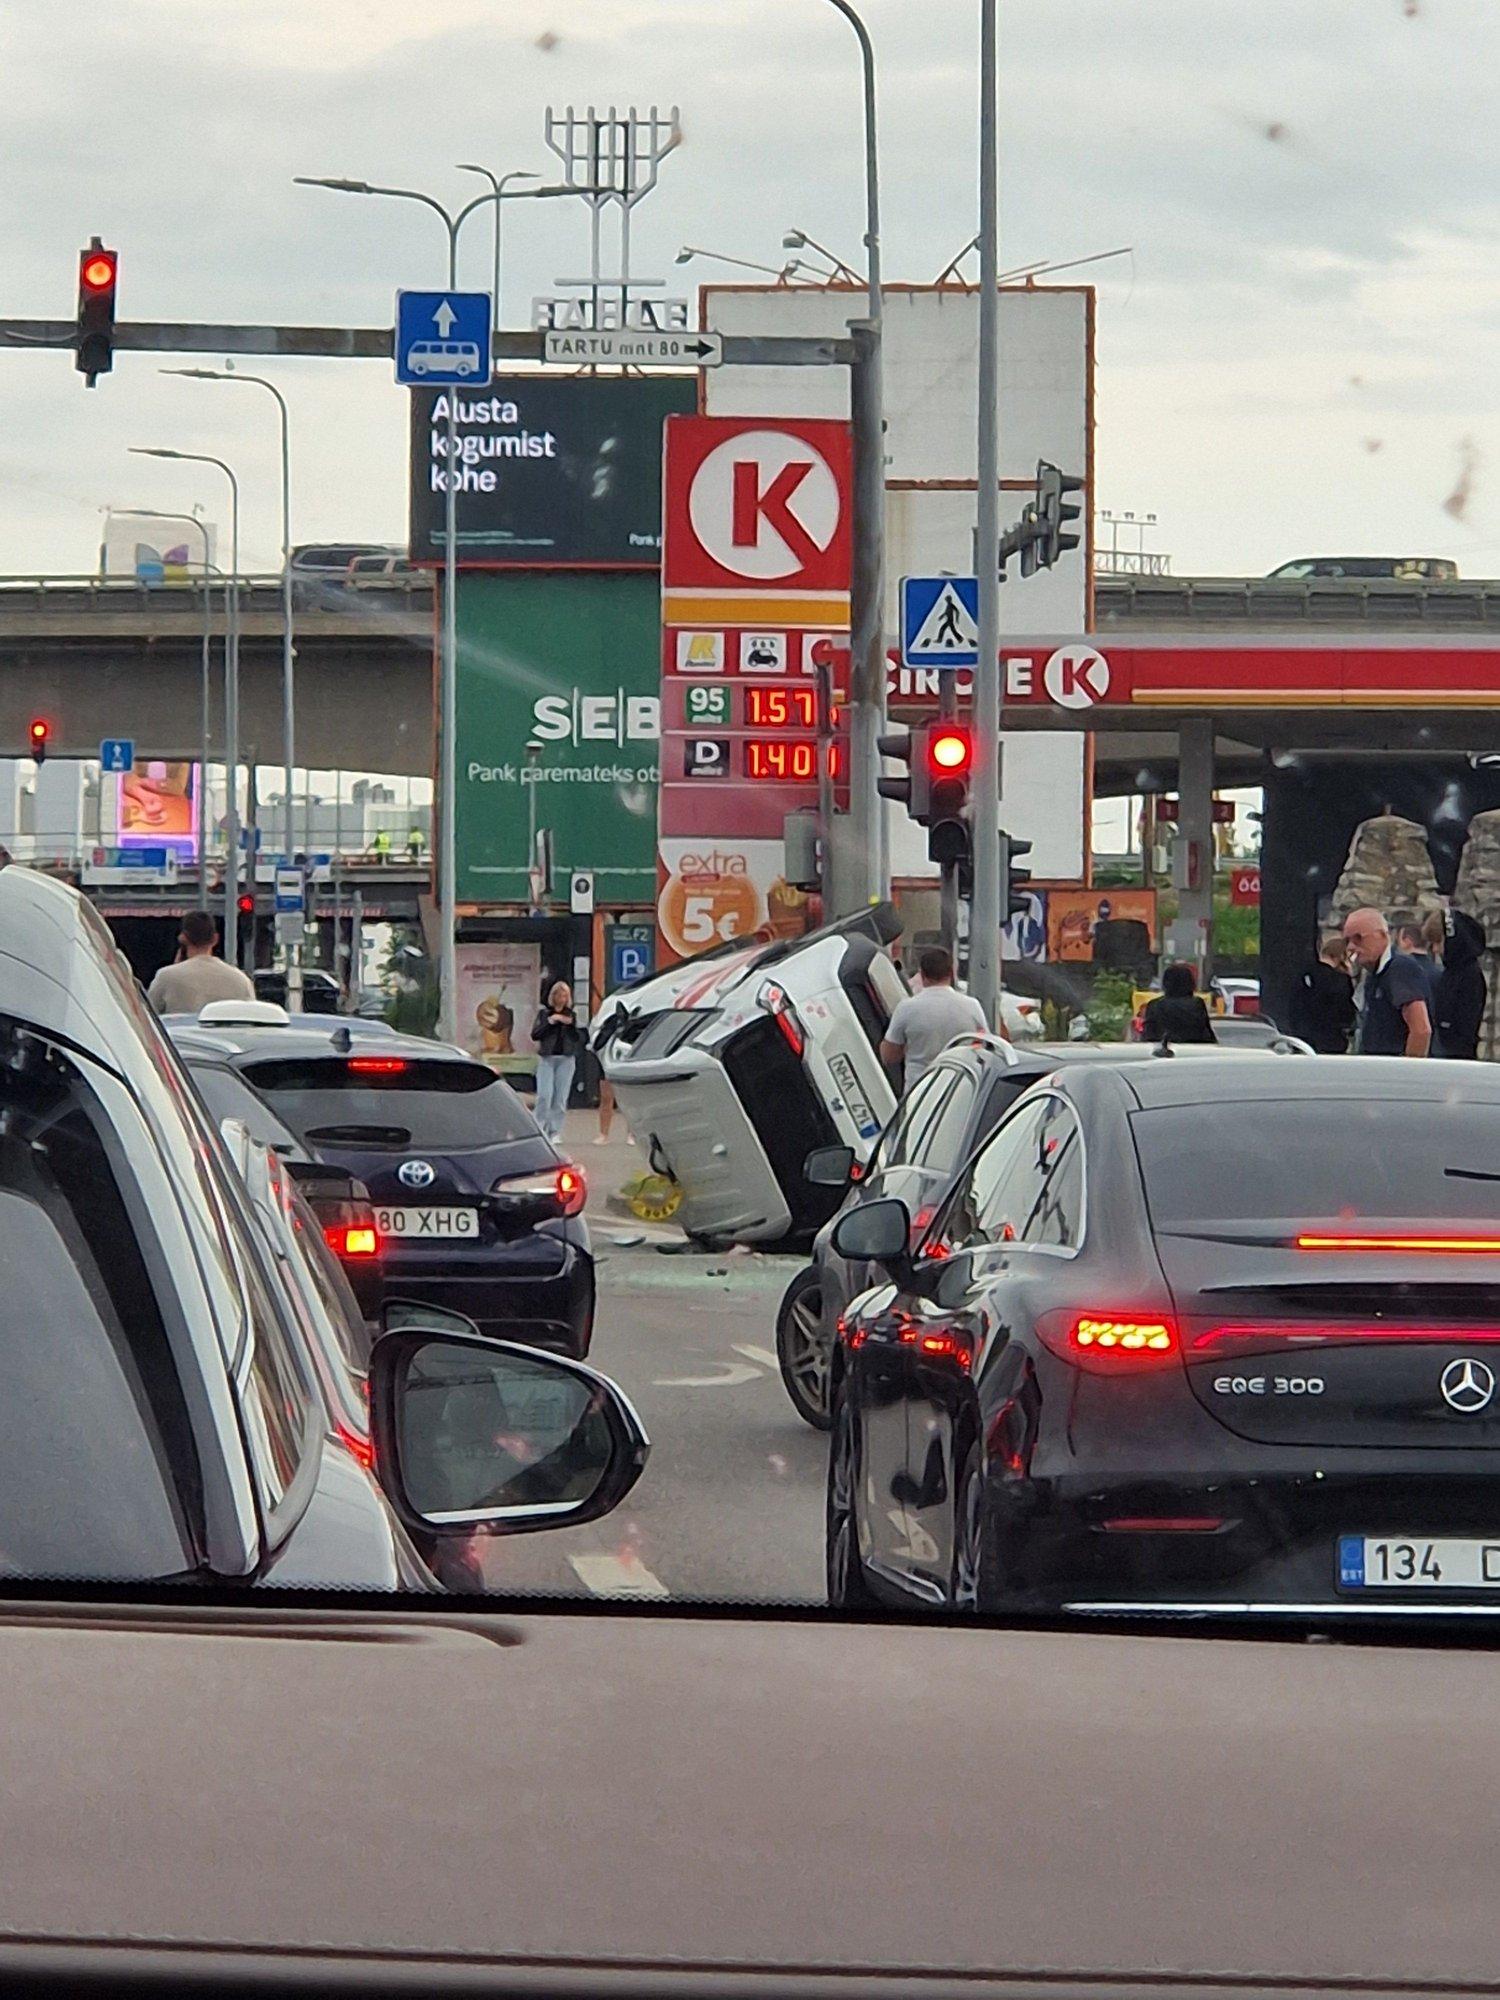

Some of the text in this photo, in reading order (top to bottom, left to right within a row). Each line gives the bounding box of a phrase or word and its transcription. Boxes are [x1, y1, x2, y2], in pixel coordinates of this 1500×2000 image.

[551, 338, 679, 356] TARTU mnt 80
[431, 395, 518, 424] Alusta
[431, 429, 556, 465] kogumist
[431, 464, 497, 492] kohe
[733, 461, 824, 570] K
[1062, 658, 1102, 705] K
[690, 688, 725, 712] 95
[695, 742, 720, 763] D
[468, 762, 516, 781] Pank
[520, 764, 633, 785] paremateks
[679, 850, 747, 874] extra
[683, 897, 739, 942] 5€
[622, 949, 640, 979] P
[418, 1210, 471, 1233] XHG
[1214, 1376, 1325, 1394] EQE 300
[1375, 1544, 1442, 1581] 134
